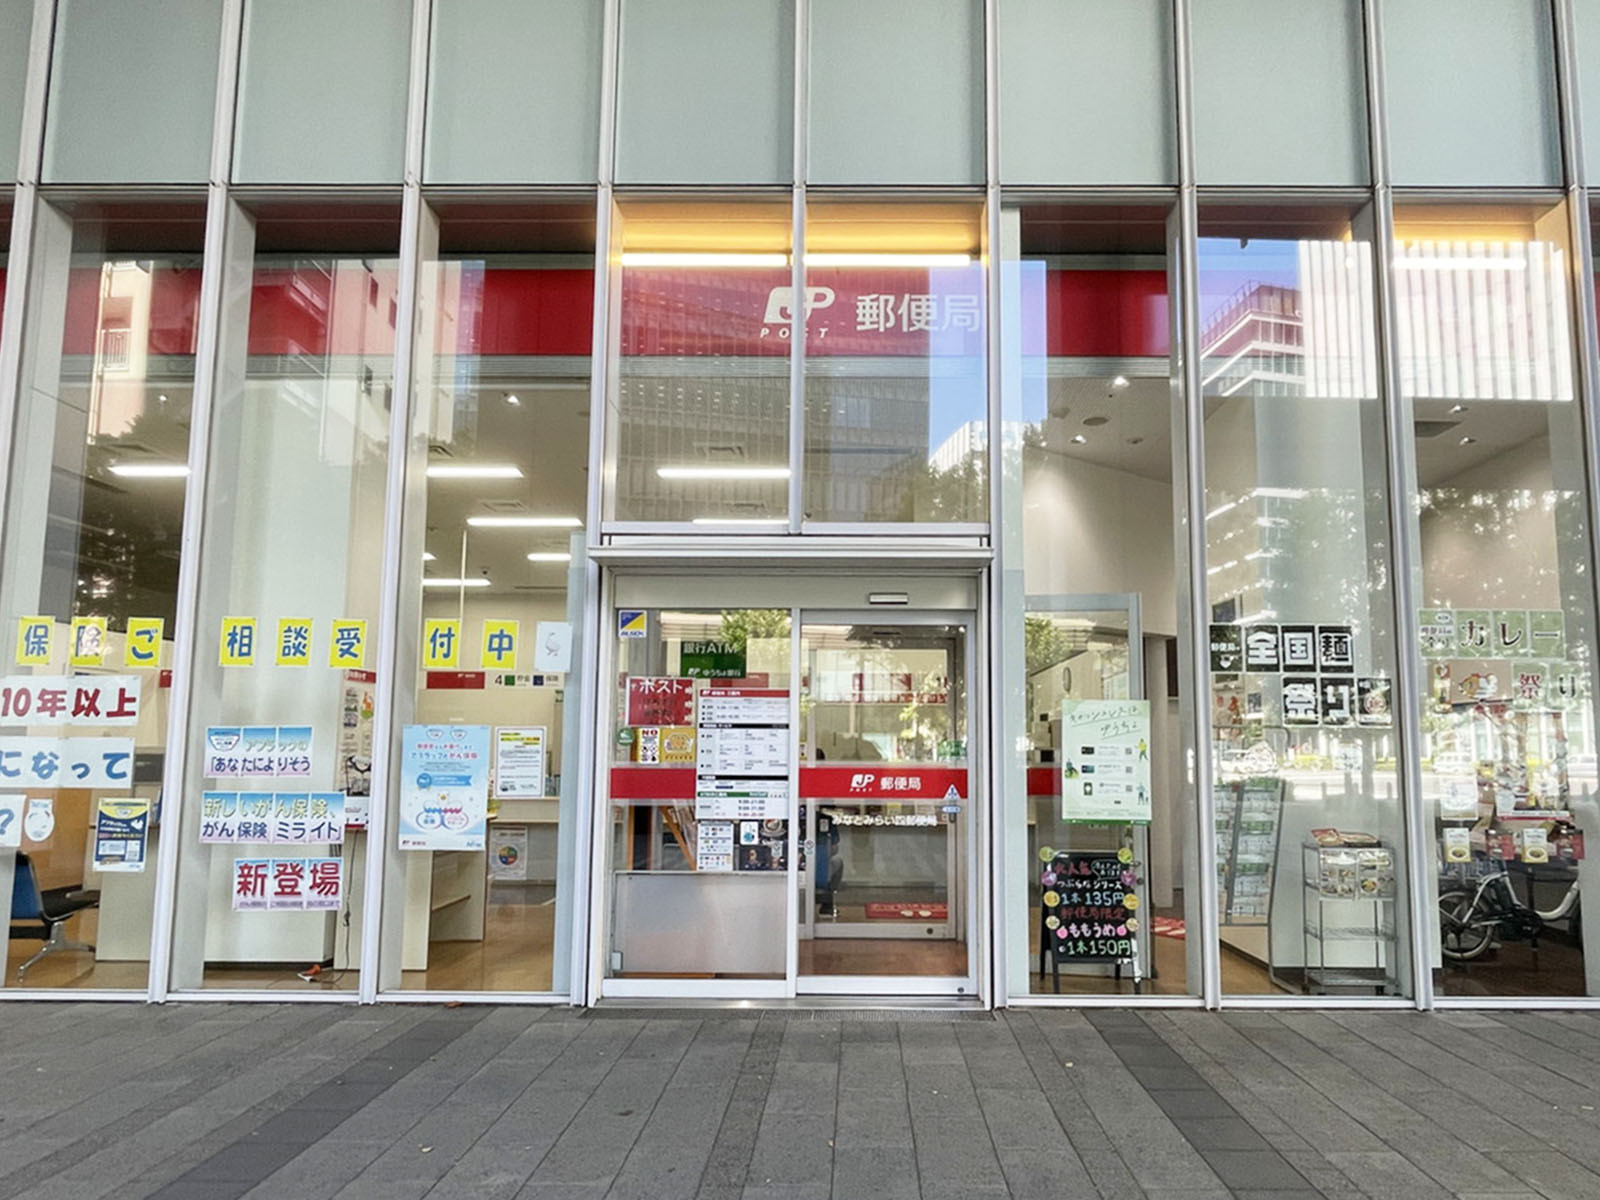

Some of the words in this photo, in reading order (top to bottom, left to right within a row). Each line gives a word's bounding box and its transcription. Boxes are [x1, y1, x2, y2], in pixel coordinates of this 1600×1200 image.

[856, 294, 980, 332] 郵便局
[1460, 620, 1559, 647] カレー
[640, 680, 683, 694] ポスト
[1, 687, 137, 718] 10年以上
[0, 751, 131, 780] になって
[880, 776, 921, 790] 郵便局
[236, 863, 341, 897] 新登場
[1068, 922, 1116, 938] ももうめ
